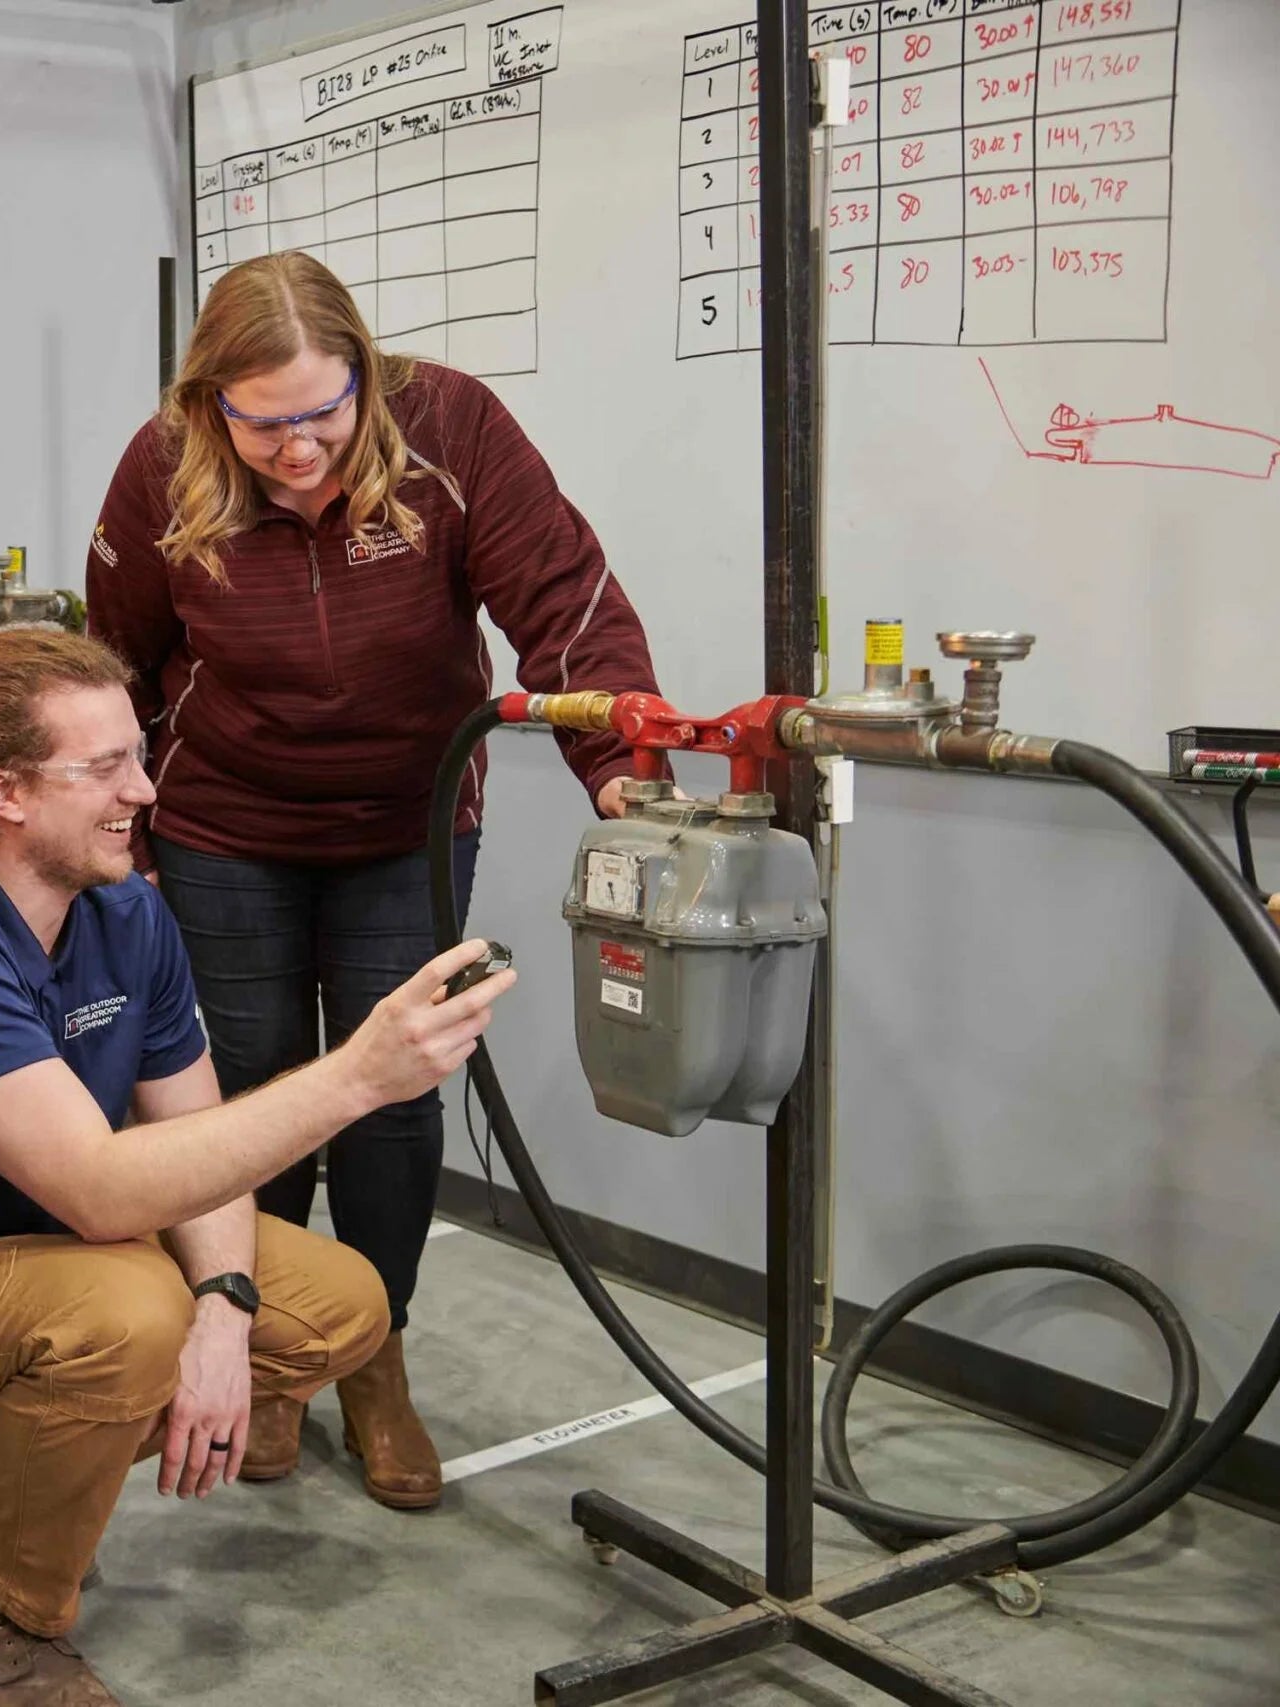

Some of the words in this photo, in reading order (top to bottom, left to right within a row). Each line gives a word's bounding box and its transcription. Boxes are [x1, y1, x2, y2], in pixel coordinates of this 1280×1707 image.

[811, 14, 844, 36] Time
[693, 39, 729, 62] Level
[362, 65, 379, 87] LP
[708, 77, 713, 98] 1
[903, 34, 931, 62] 80
[1053, 55, 1140, 87] 147,360
[701, 128, 712, 145] 2
[901, 86, 922, 115] 82
[702, 172, 713, 189] 3
[901, 141, 925, 168] 82
[1047, 120, 1136, 155] 144,733
[705, 225, 714, 250] 4
[897, 193, 920, 221] 80
[702, 295, 717, 326] 5
[900, 257, 929, 288] 80
[1052, 247, 1123, 278] 103,375
[373, 545, 410, 560] COMPANY
[90, 995, 127, 1010] OUTDOOR
[80, 1016, 112, 1031] COMPANY
